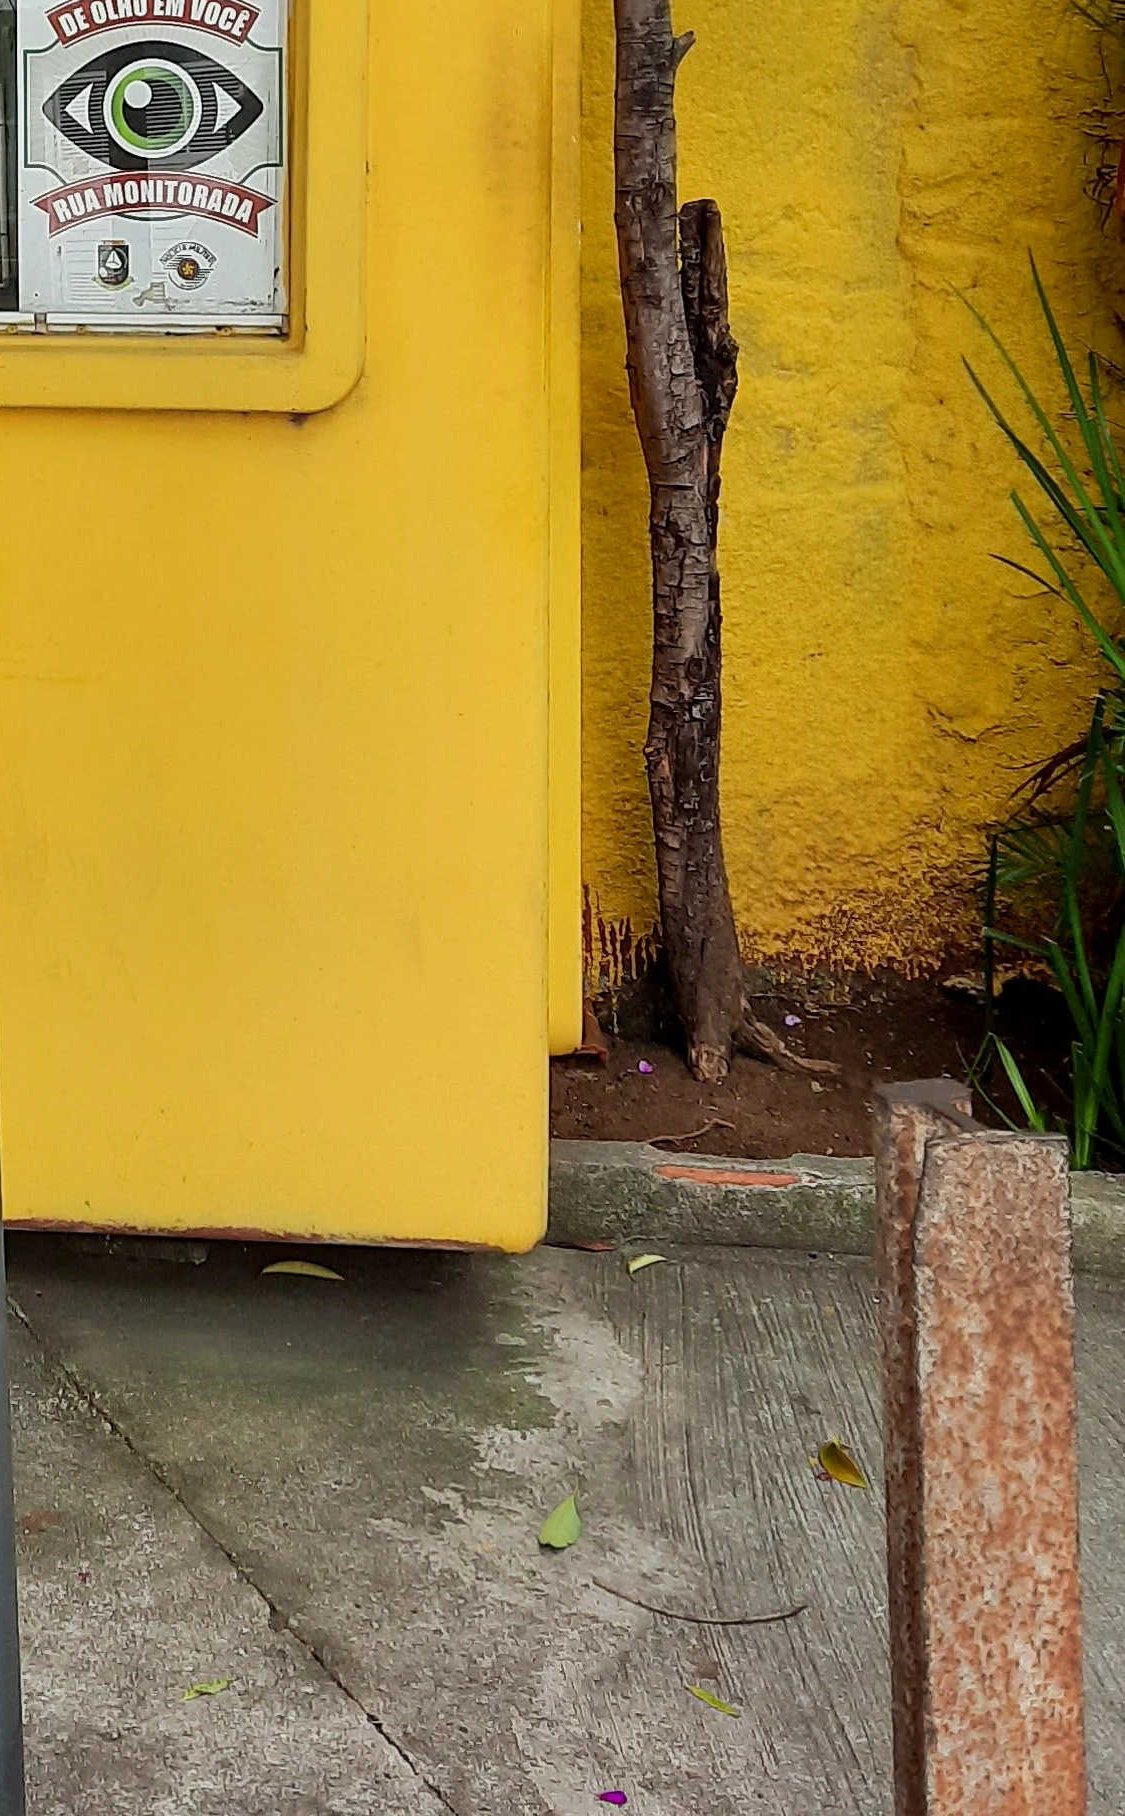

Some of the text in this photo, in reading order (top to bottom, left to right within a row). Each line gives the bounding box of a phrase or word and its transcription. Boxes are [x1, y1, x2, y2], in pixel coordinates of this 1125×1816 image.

[58, 6, 90, 37] DE
[52, 179, 254, 224] RUA MONITORADA
